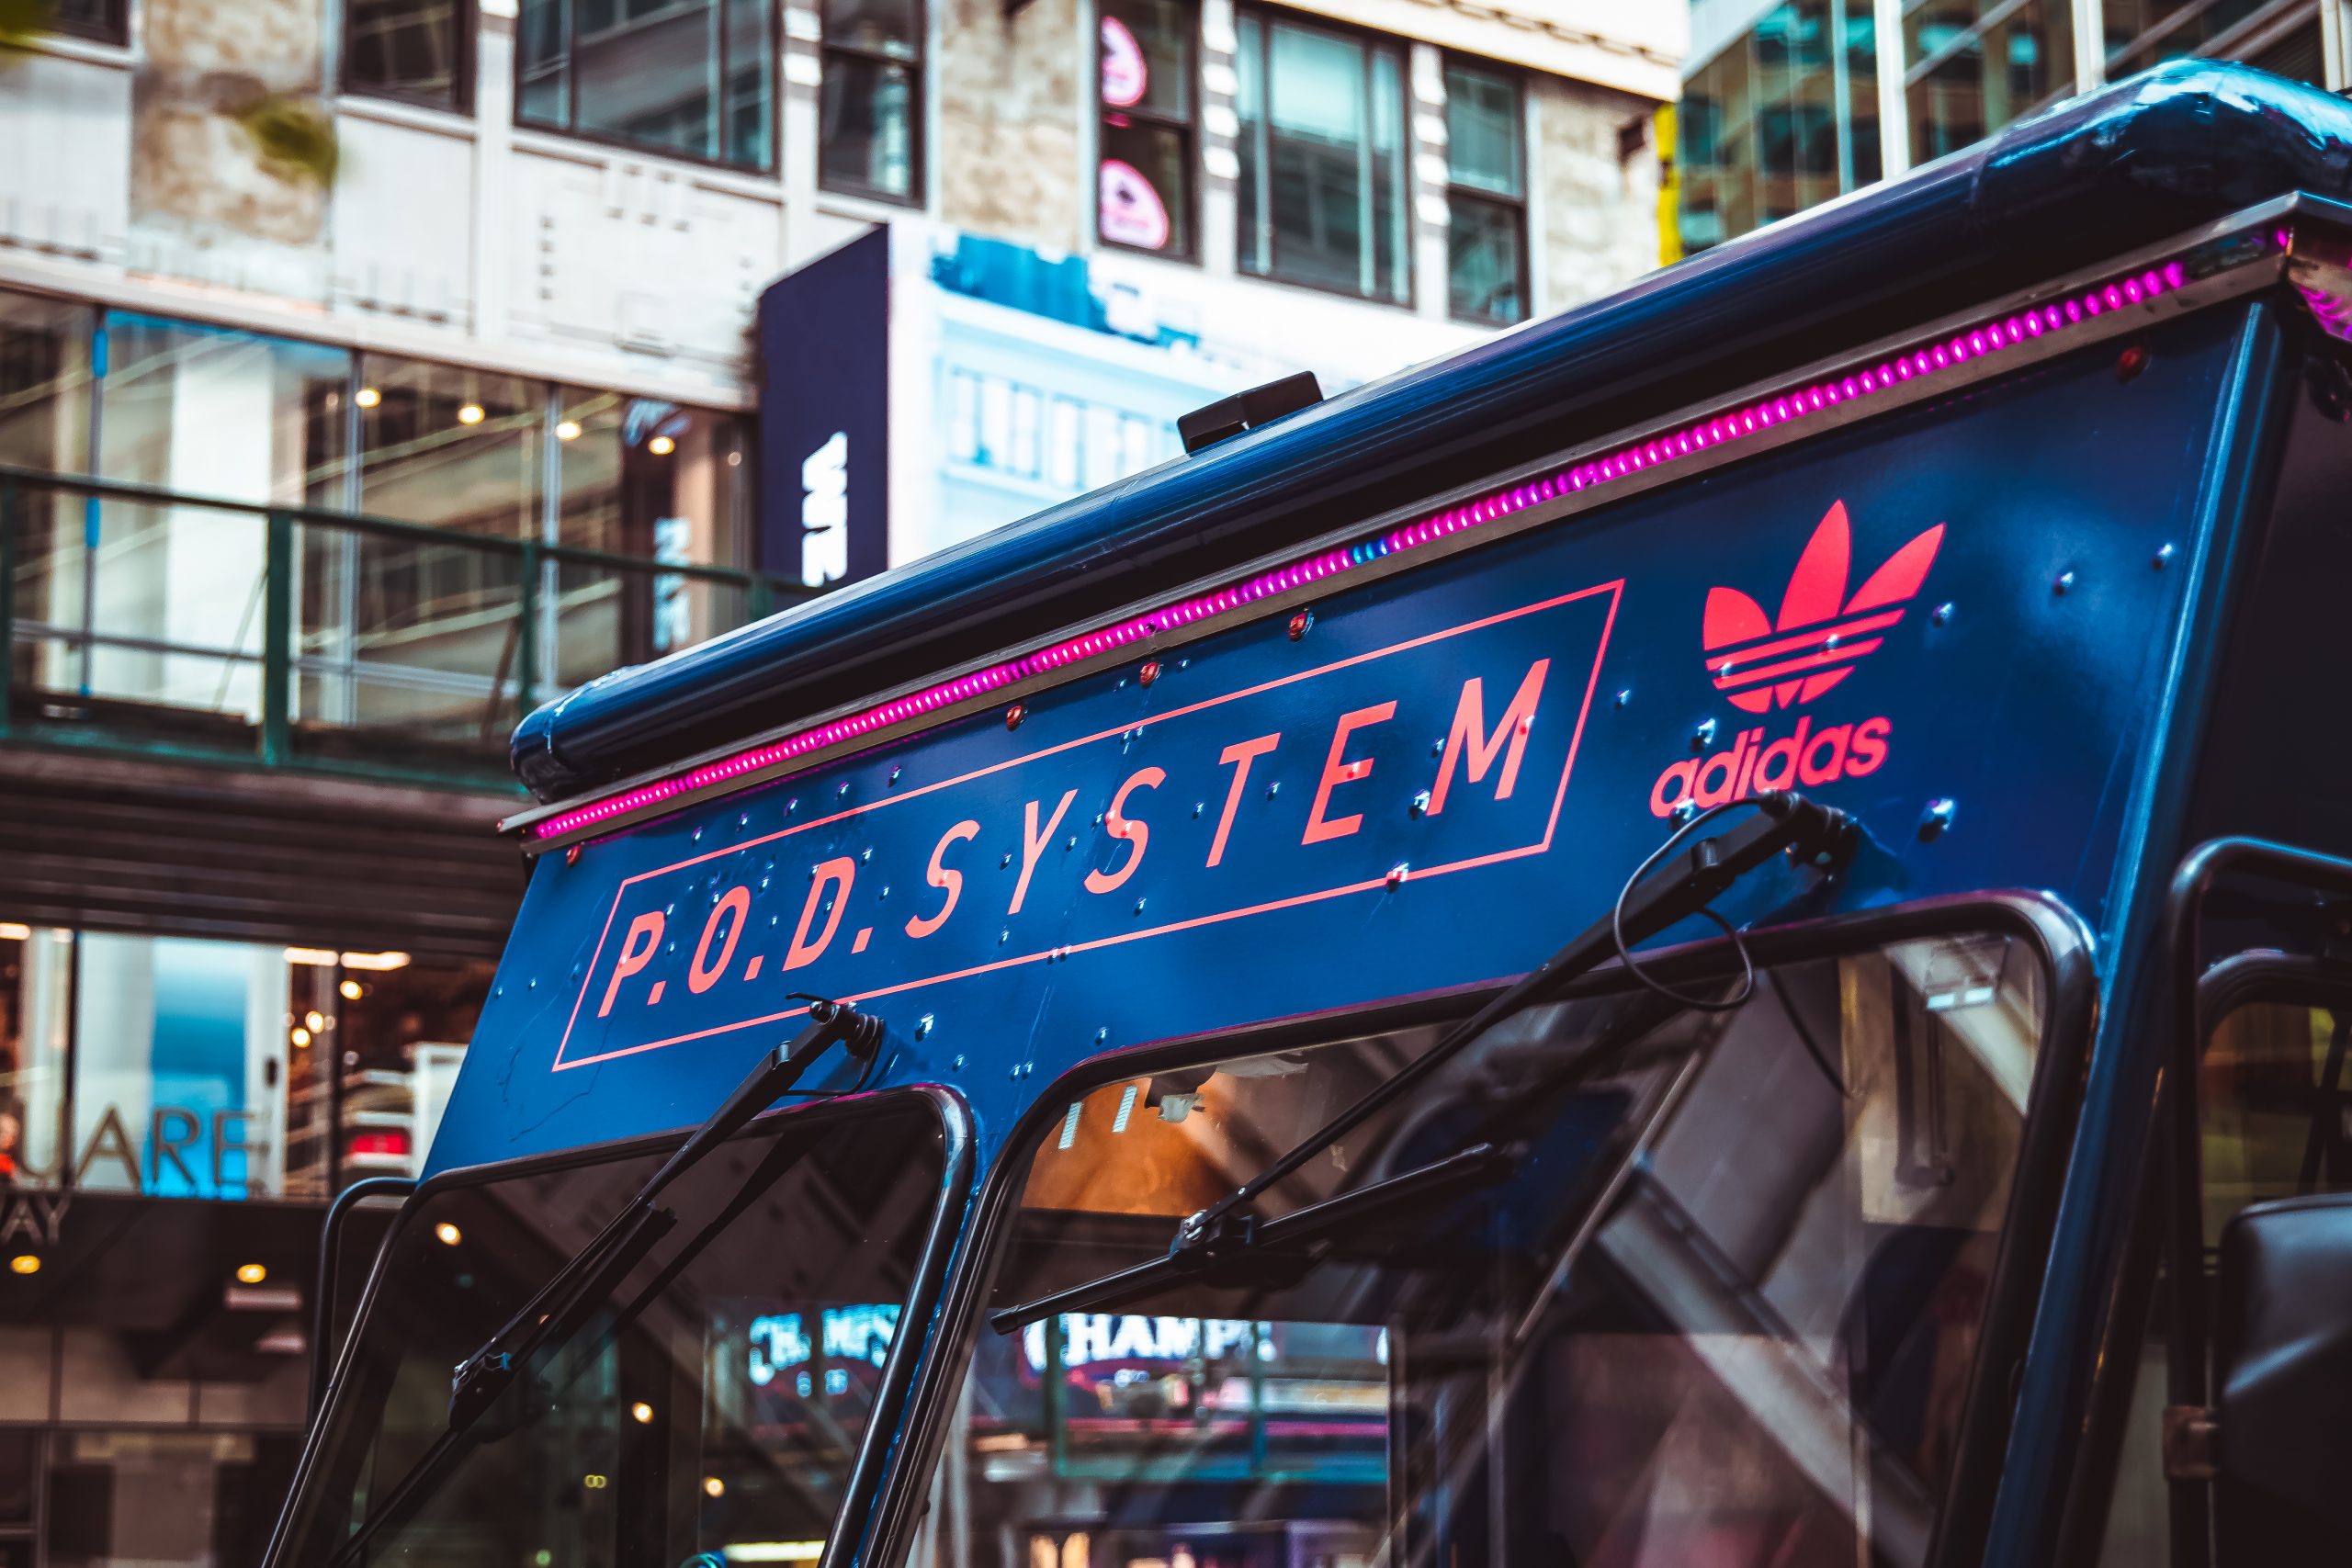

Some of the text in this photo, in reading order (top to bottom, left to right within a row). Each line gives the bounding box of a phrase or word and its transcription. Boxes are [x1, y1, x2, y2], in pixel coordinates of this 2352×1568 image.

[1650, 715, 1893, 818] adidas
[597, 658, 1551, 1019] P.O.D. SYSTEM
[0, 1194, 72, 1245] AY
